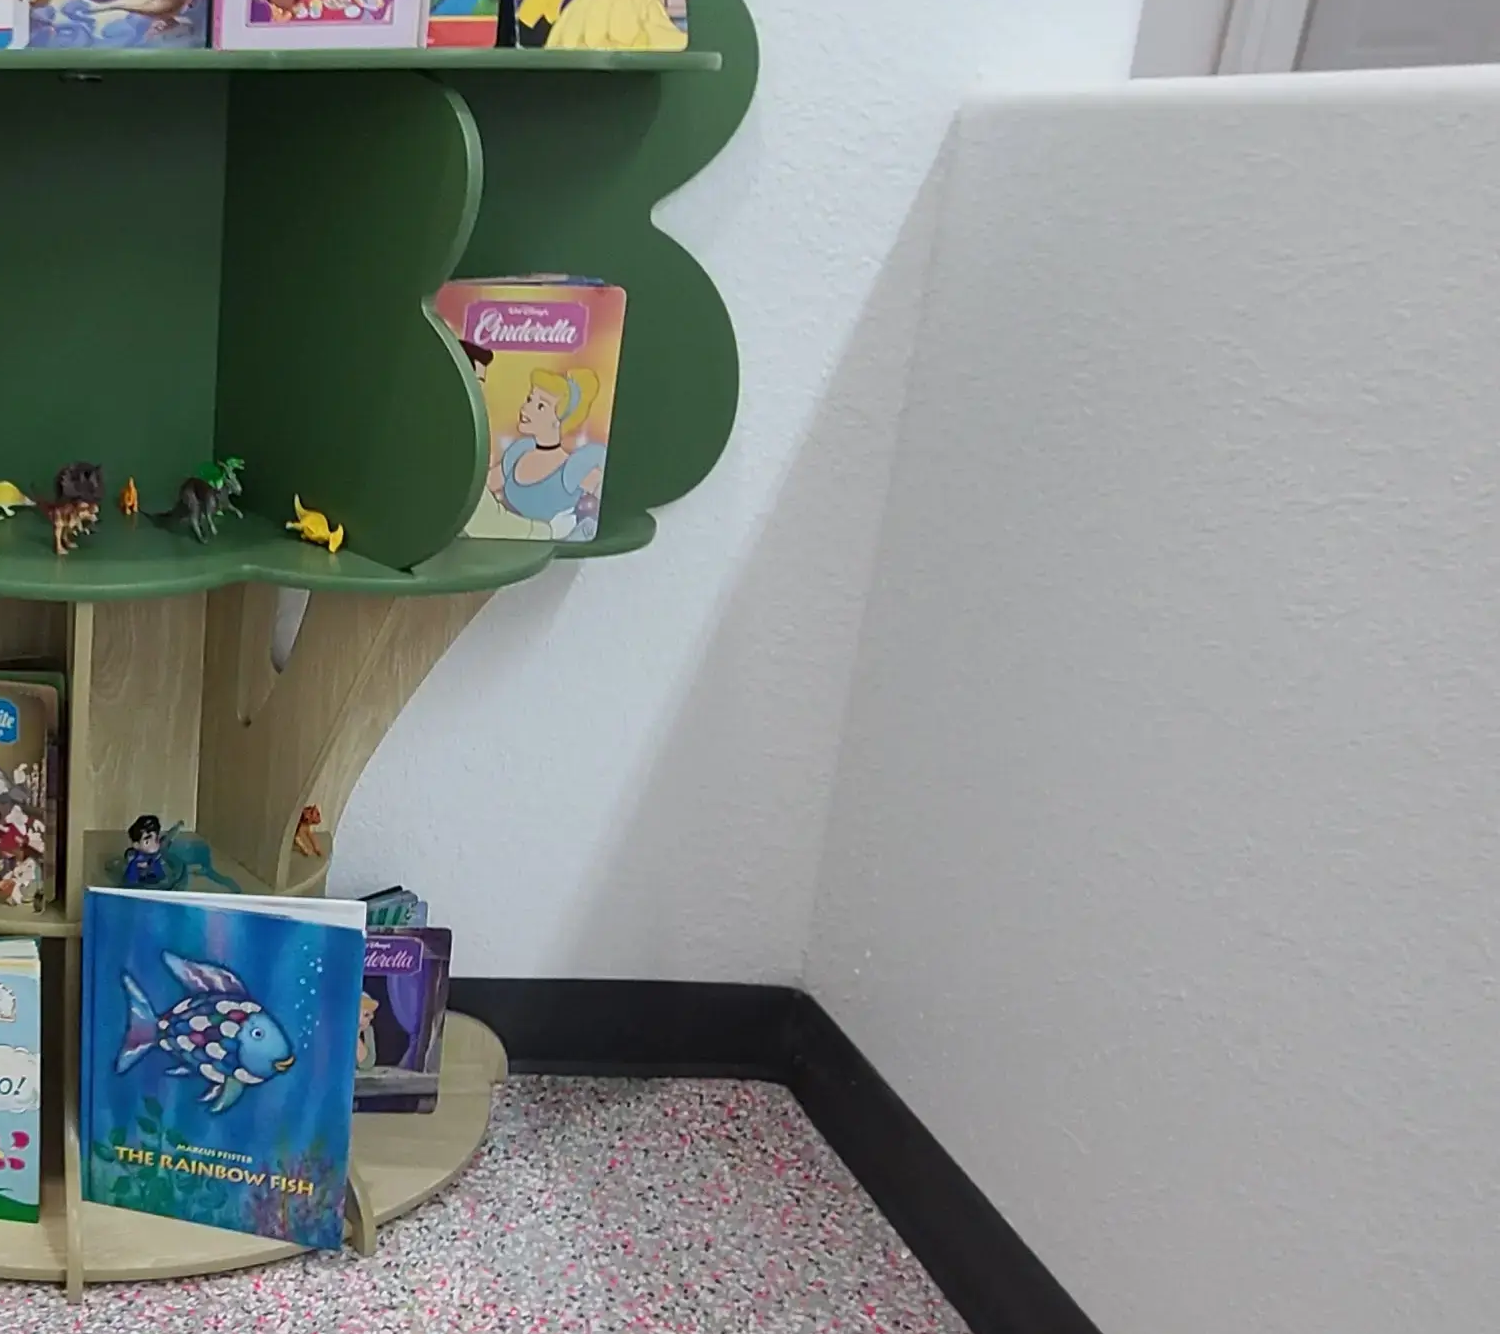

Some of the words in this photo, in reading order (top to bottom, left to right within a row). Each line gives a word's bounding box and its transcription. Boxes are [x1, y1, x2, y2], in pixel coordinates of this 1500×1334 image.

[474, 308, 579, 345] Cinderella
[364, 950, 414, 968] derella
[176, 1143, 216, 1157] MARCUS
[115, 1146, 155, 1166] THE
[159, 1154, 266, 1187] RAINBOW
[269, 1174, 315, 1197] FISH
